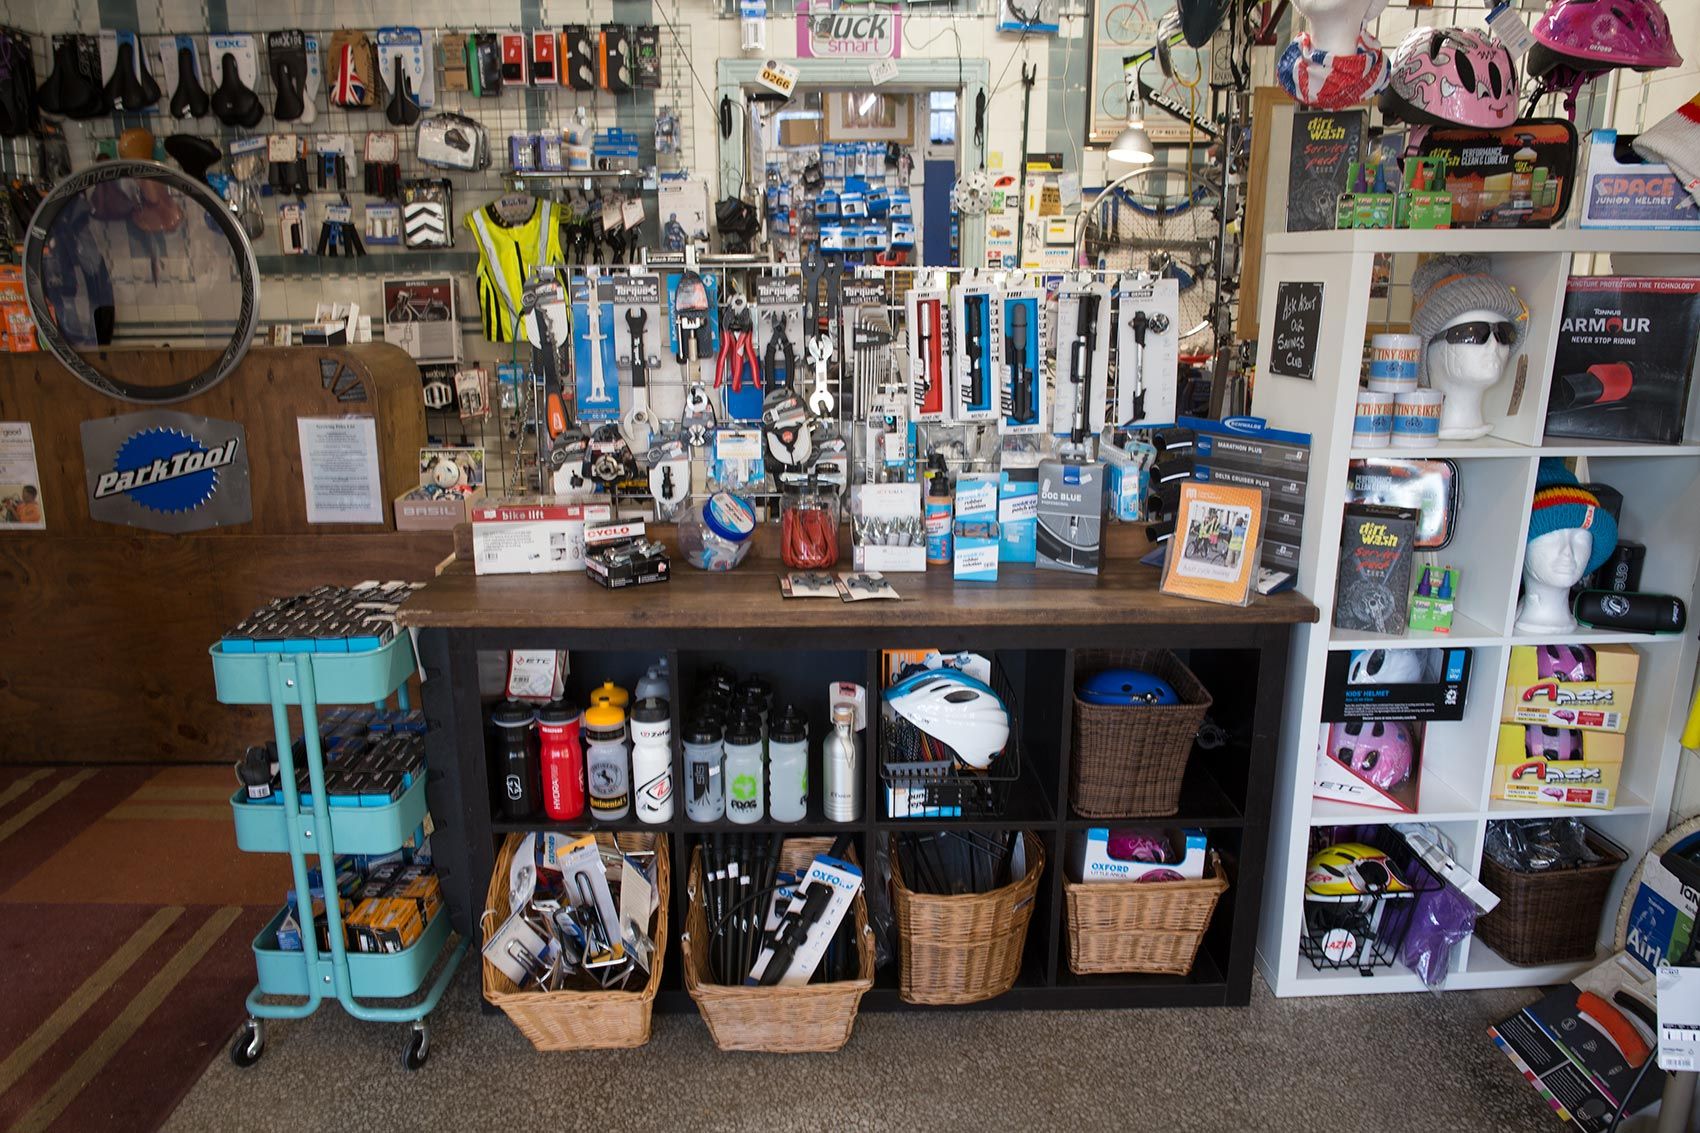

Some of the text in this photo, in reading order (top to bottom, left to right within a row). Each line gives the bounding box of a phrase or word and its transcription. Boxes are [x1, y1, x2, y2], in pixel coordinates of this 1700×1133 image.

[828, 39, 880, 53] smart
[761, 70, 790, 91] 0266
[1307, 117, 1335, 132] dirt
[1310, 127, 1345, 141] wash
[1462, 147, 1503, 158] PERFORMANCE
[1461, 156, 1480, 166] CLEAN
[1500, 154, 1509, 164] KIT
[1595, 196, 1673, 205] JUNIOR HELMET
[1600, 281, 1637, 289] PROTECTION
[1639, 281, 1652, 289] TIRE
[1654, 281, 1695, 290] TECHNOLOGY
[1561, 316, 1651, 335] ARMOUR
[1571, 336, 1637, 345] NEVER STOP RIDING
[1378, 349, 1397, 361] TINY
[1362, 403, 1382, 416] TINY
[1417, 404, 1441, 418] BIKES
[1217, 441, 1263, 454] MARATHON PLUS
[1215, 472, 1270, 487] DELTA CRUISER PLUS
[1041, 491, 1082, 502] DOC BLUE
[403, 506, 457, 517] BASIL
[502, 510, 545, 520] bike lift
[587, 526, 630, 538] CYCLO
[1359, 522, 1388, 538] dirt
[1362, 533, 1399, 548] wash
[1363, 689, 1390, 697] HELMET
[1320, 780, 1365, 794] ETC
[730, 800, 758, 809] FROG
[1091, 862, 1130, 874] OXFORD
[1326, 940, 1353, 949] AZER
